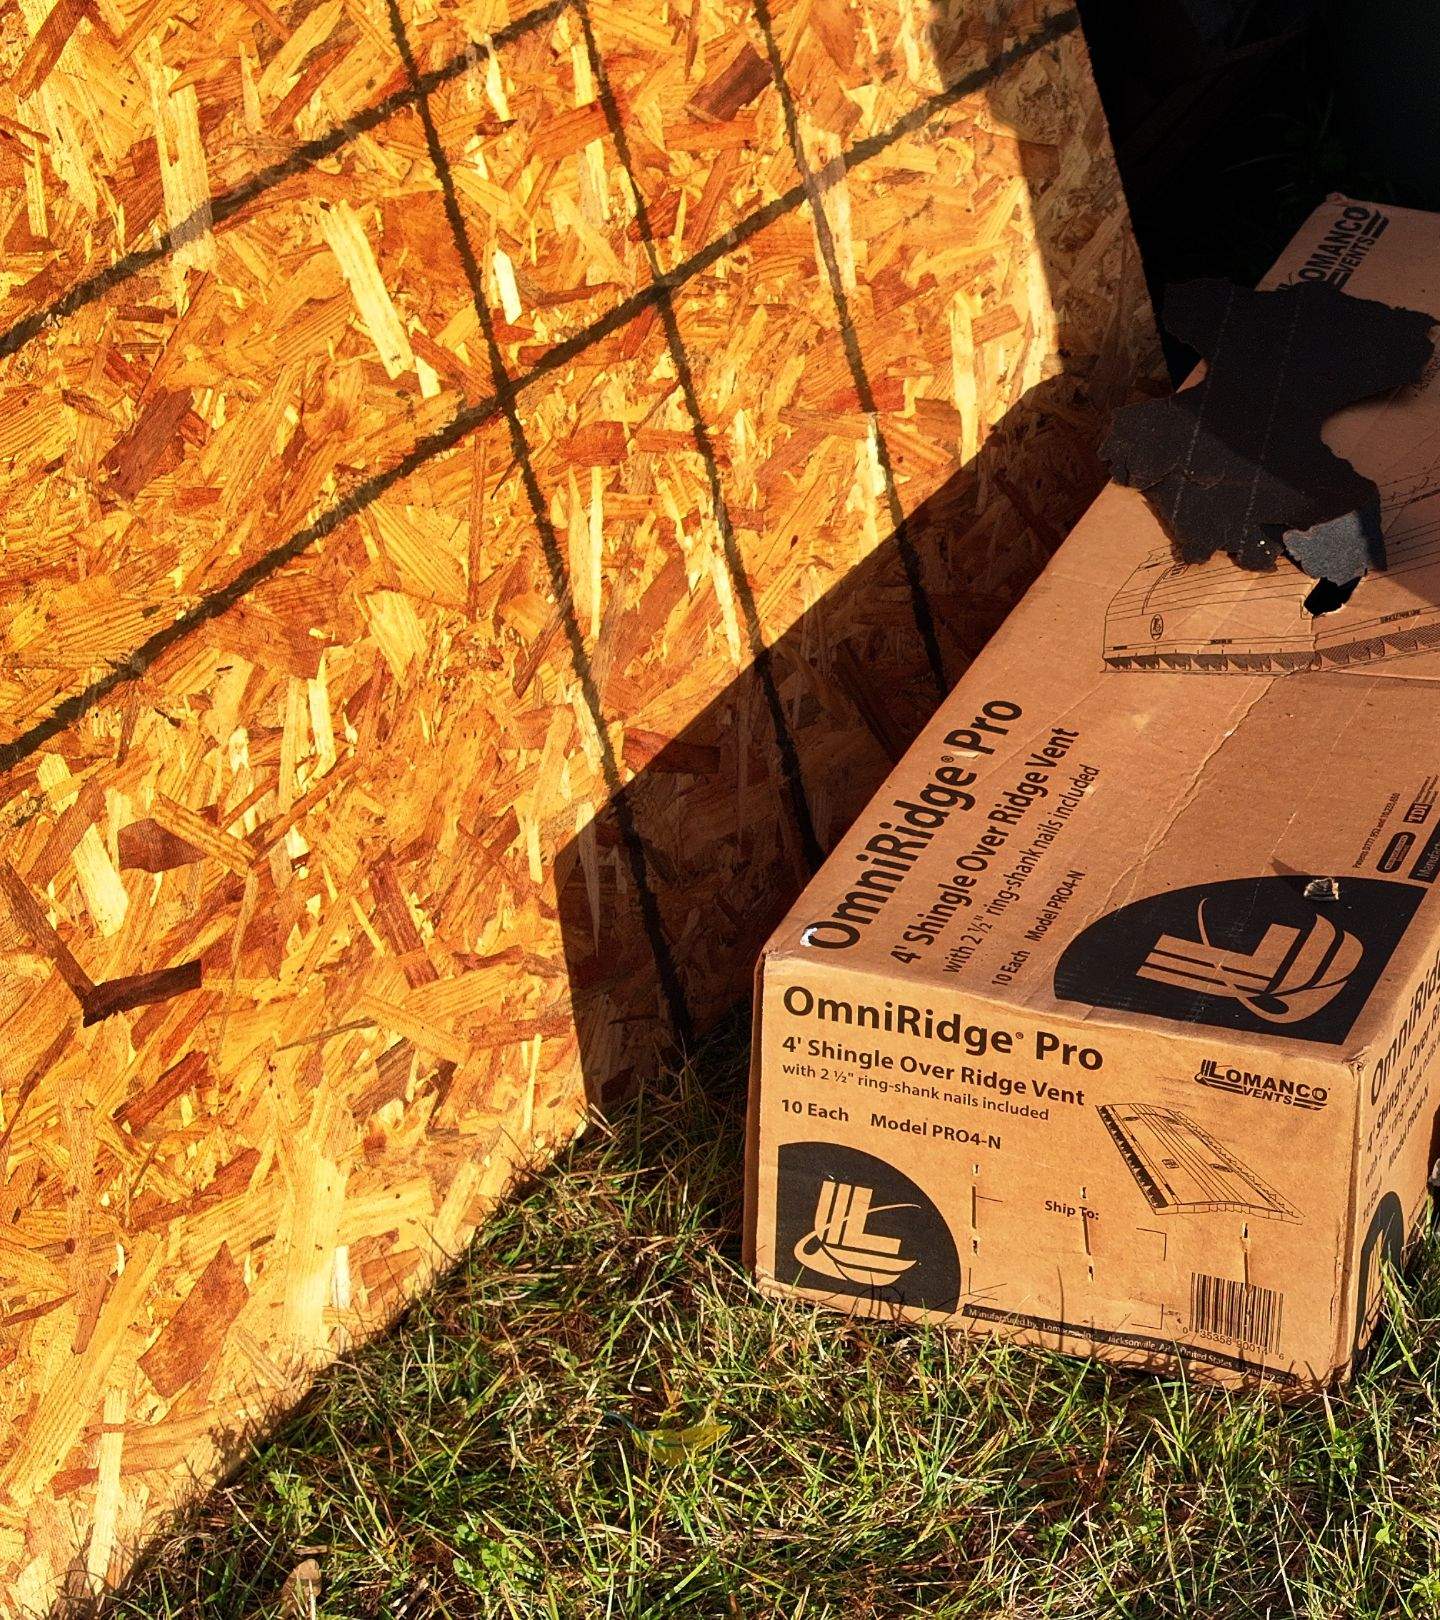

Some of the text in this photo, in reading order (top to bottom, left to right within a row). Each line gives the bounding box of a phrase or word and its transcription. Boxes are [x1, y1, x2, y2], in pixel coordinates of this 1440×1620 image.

[1280, 207, 1370, 290] OMANCO
[1339, 236, 1375, 272] VENTS
[943, 700, 1023, 755] Pro
[903, 874, 977, 946] Shingle
[956, 826, 1009, 873] Over
[987, 768, 1048, 827] Ridge
[1025, 727, 1080, 769] Vent
[943, 946, 969, 975] with
[962, 934, 974, 947] 2
[985, 847, 1043, 917] ring-shank
[1033, 811, 1062, 855] nails
[1054, 763, 1101, 825] included
[992, 870, 1086, 986] 10 Each Model PRO4-N
[808, 1040, 894, 1069] Shingle
[900, 1056, 955, 1080] Over
[961, 1067, 1027, 1096] Ridge
[1032, 1080, 1085, 1106] Vent
[1035, 1031, 1103, 1071] Pro
[782, 1064, 816, 1079] with
[820, 1068, 829, 1080] 2
[858, 1075, 940, 1100] ring-shank
[943, 1093, 979, 1108] nails
[982, 1097, 1049, 1121] included
[1200, 1059, 1330, 1102] LOMANCO
[1243, 1087, 1292, 1105] VENTS
[1375, 1065, 1409, 1140] Shingle
[1409, 1021, 1431, 1073] Over
[782, 1099, 1001, 1150] 10 Each Model PRO4-N
[1045, 1201, 1100, 1221] Ship To:
[1200, 1330, 1233, 1346] 35358
